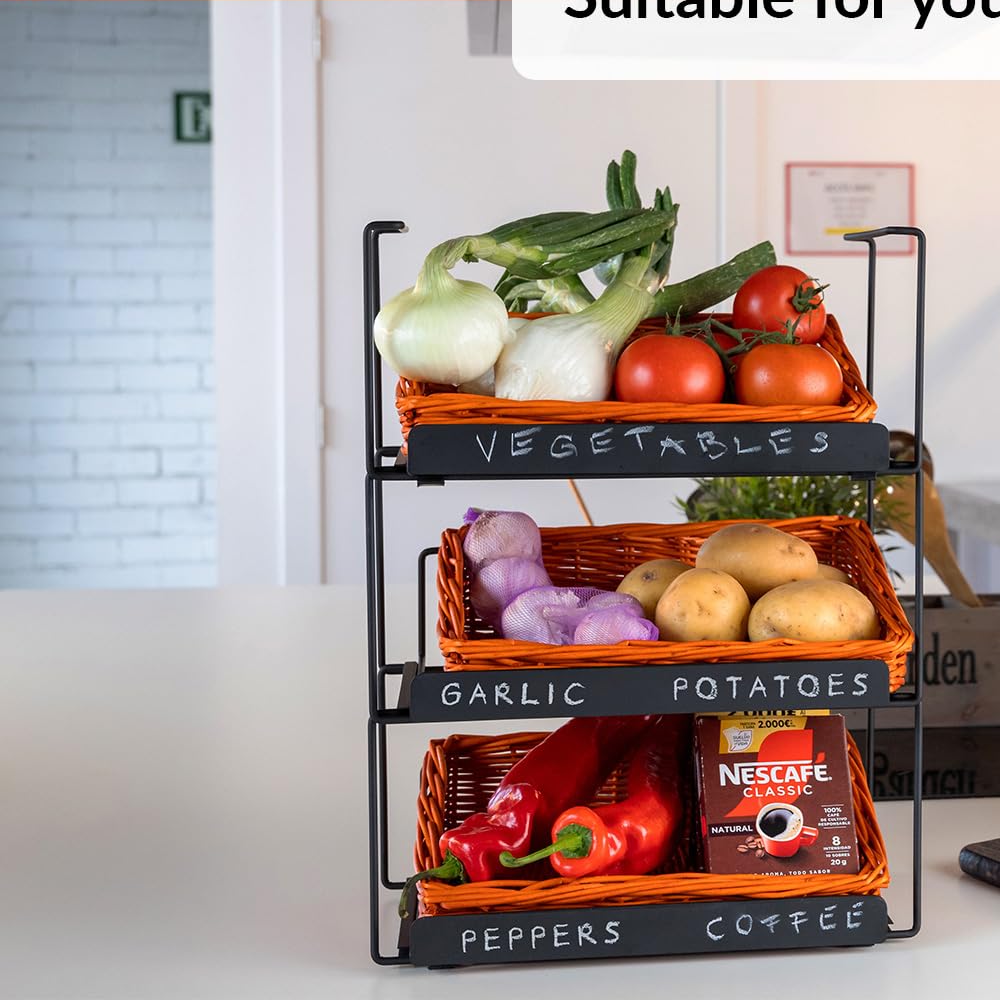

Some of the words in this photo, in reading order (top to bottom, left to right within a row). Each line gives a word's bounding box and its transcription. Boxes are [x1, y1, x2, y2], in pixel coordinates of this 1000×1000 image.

[476, 425, 829, 463] VEGETABLES
[441, 681, 586, 706] GARLIC
[673, 673, 869, 701] POTATOES
[757, 719, 791, 729] 2.000€
[743, 785, 813, 798] CLASSIC
[711, 824, 753, 834] NATURAL
[832, 835, 841, 846] 8
[461, 921, 621, 953] PEPPERS
